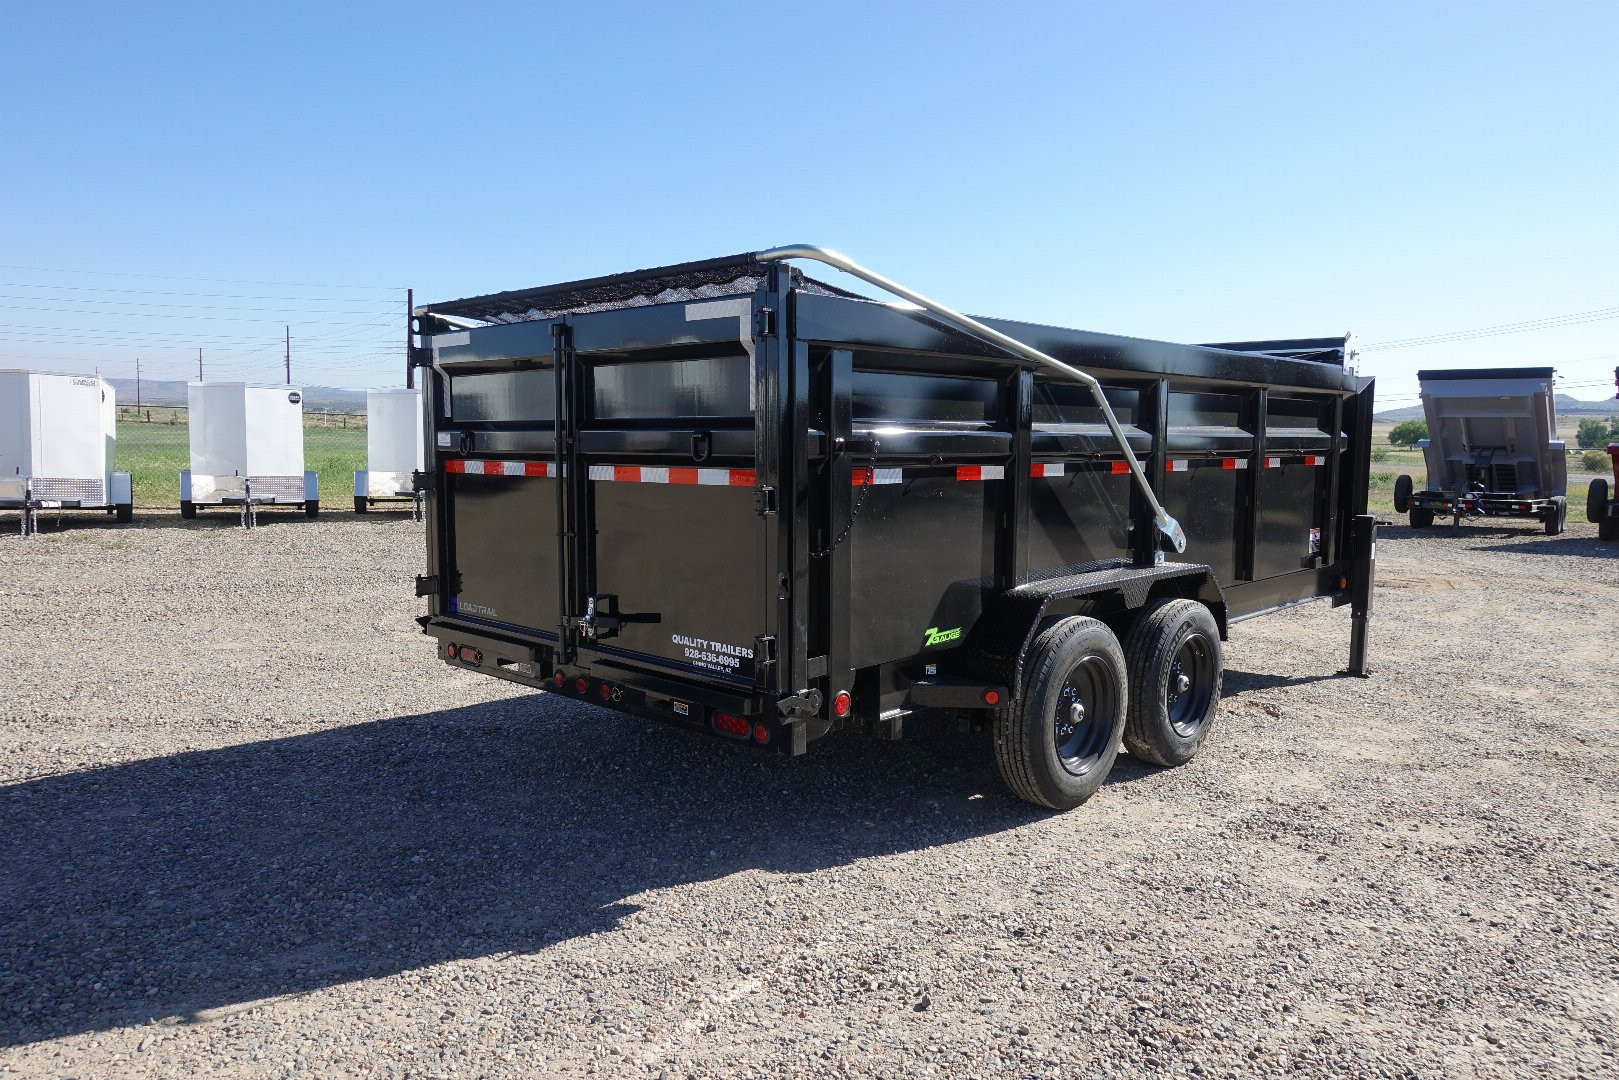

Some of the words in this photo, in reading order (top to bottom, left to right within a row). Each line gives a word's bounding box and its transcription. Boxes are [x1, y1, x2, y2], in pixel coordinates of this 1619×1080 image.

[459, 601, 498, 616] LOADTRAIL
[672, 634, 708, 649] QUALITY
[710, 641, 754, 658] TRAILERS
[924, 627, 938, 647] 7
[932, 631, 961, 645] GAUGE
[684, 647, 740, 667] 928-636-6995
